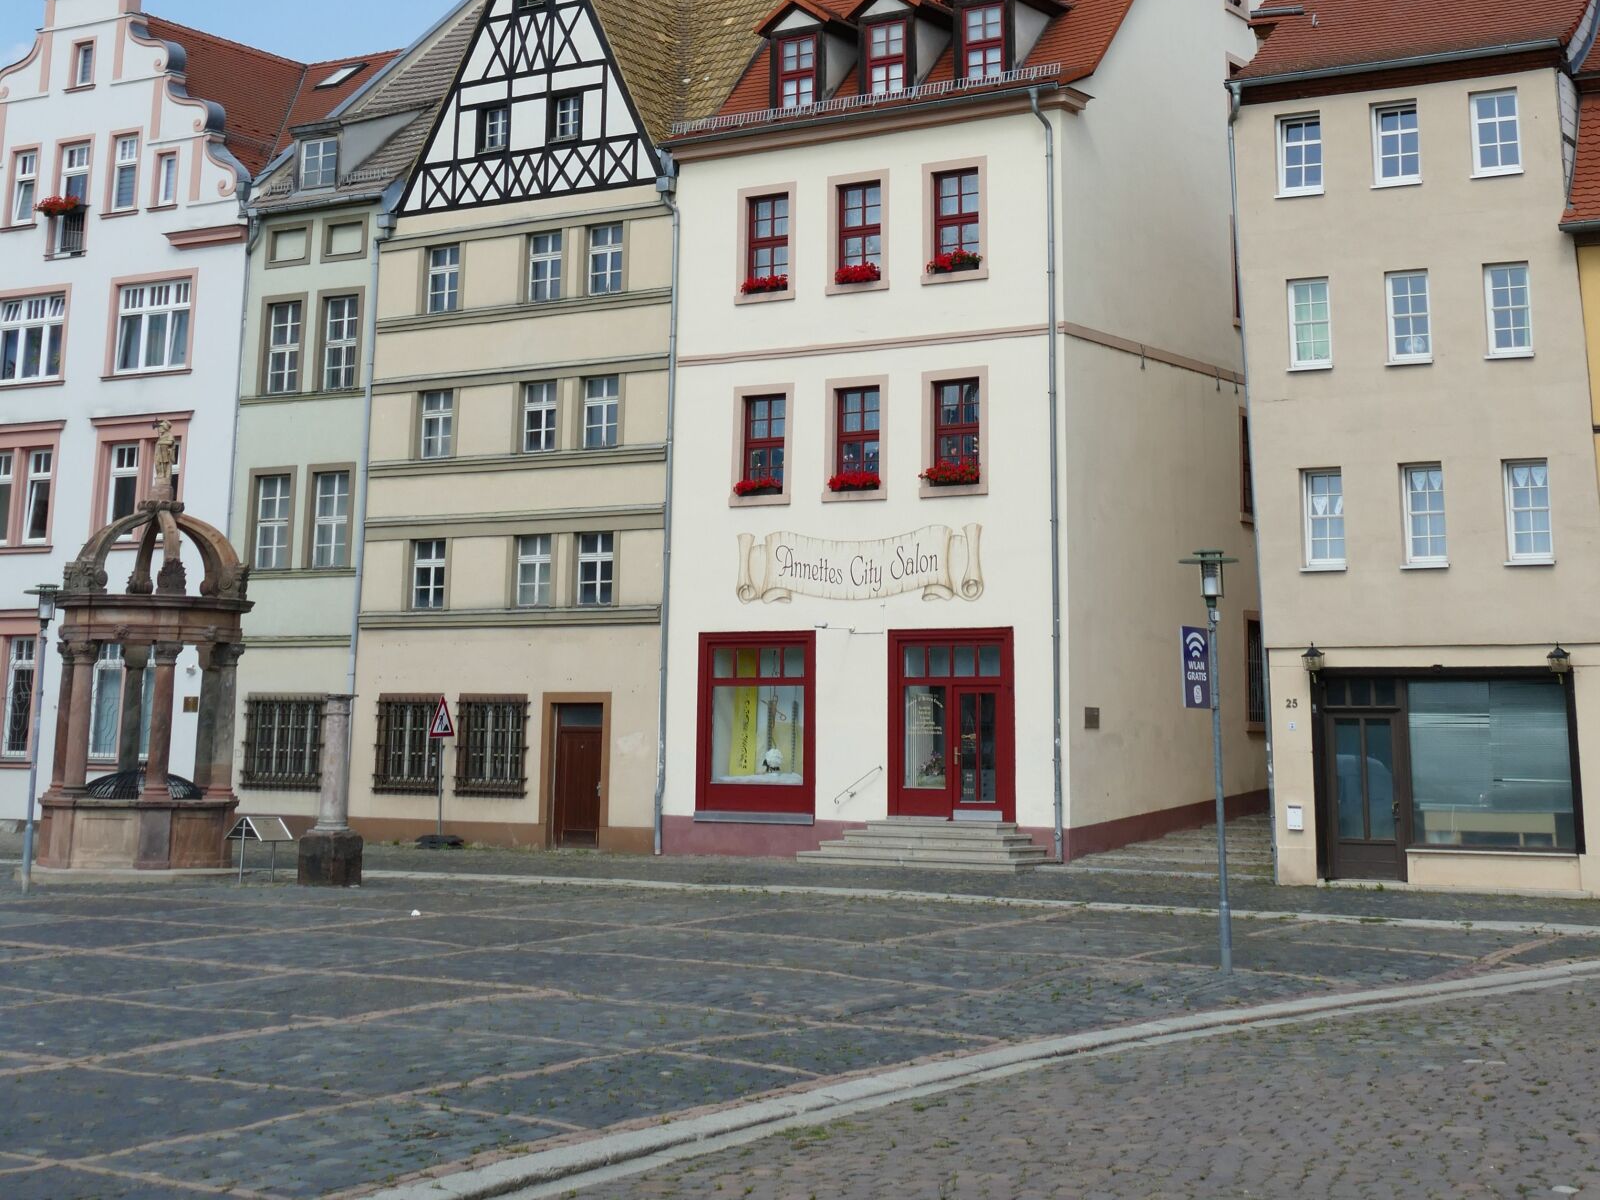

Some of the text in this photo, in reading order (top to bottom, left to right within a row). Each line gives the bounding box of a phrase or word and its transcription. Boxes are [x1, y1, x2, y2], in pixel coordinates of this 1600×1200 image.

[775, 542, 939, 592] Annettes City Salon
[1188, 660, 1205, 671] WLAN
[1187, 671, 1207, 681] GRATIS
[1285, 698, 1298, 709] 25
